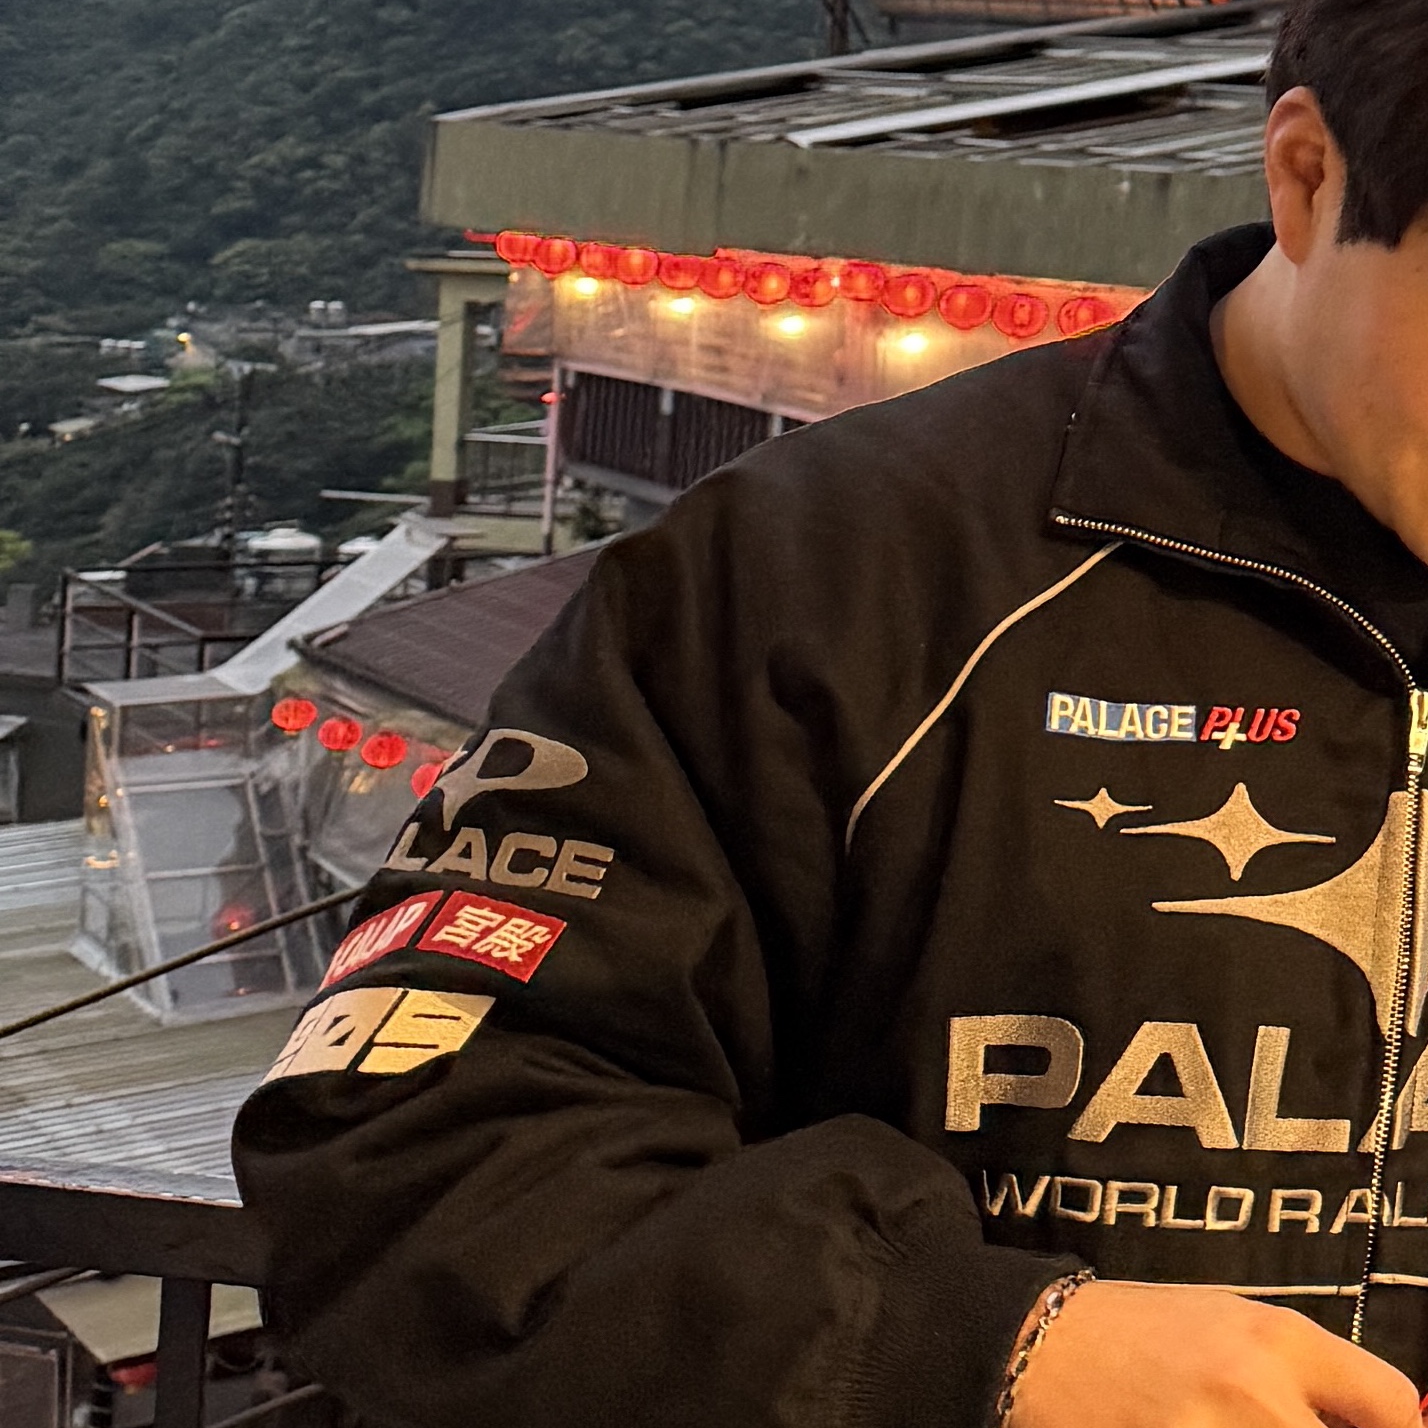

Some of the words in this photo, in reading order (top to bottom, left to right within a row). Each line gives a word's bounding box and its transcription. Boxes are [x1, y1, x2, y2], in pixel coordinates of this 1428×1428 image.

[1049, 693, 1194, 740] PALACE
[1200, 706, 1301, 748] PLUS
[378, 822, 615, 900] LACE
[983, 1170, 1254, 1231] WORLD
